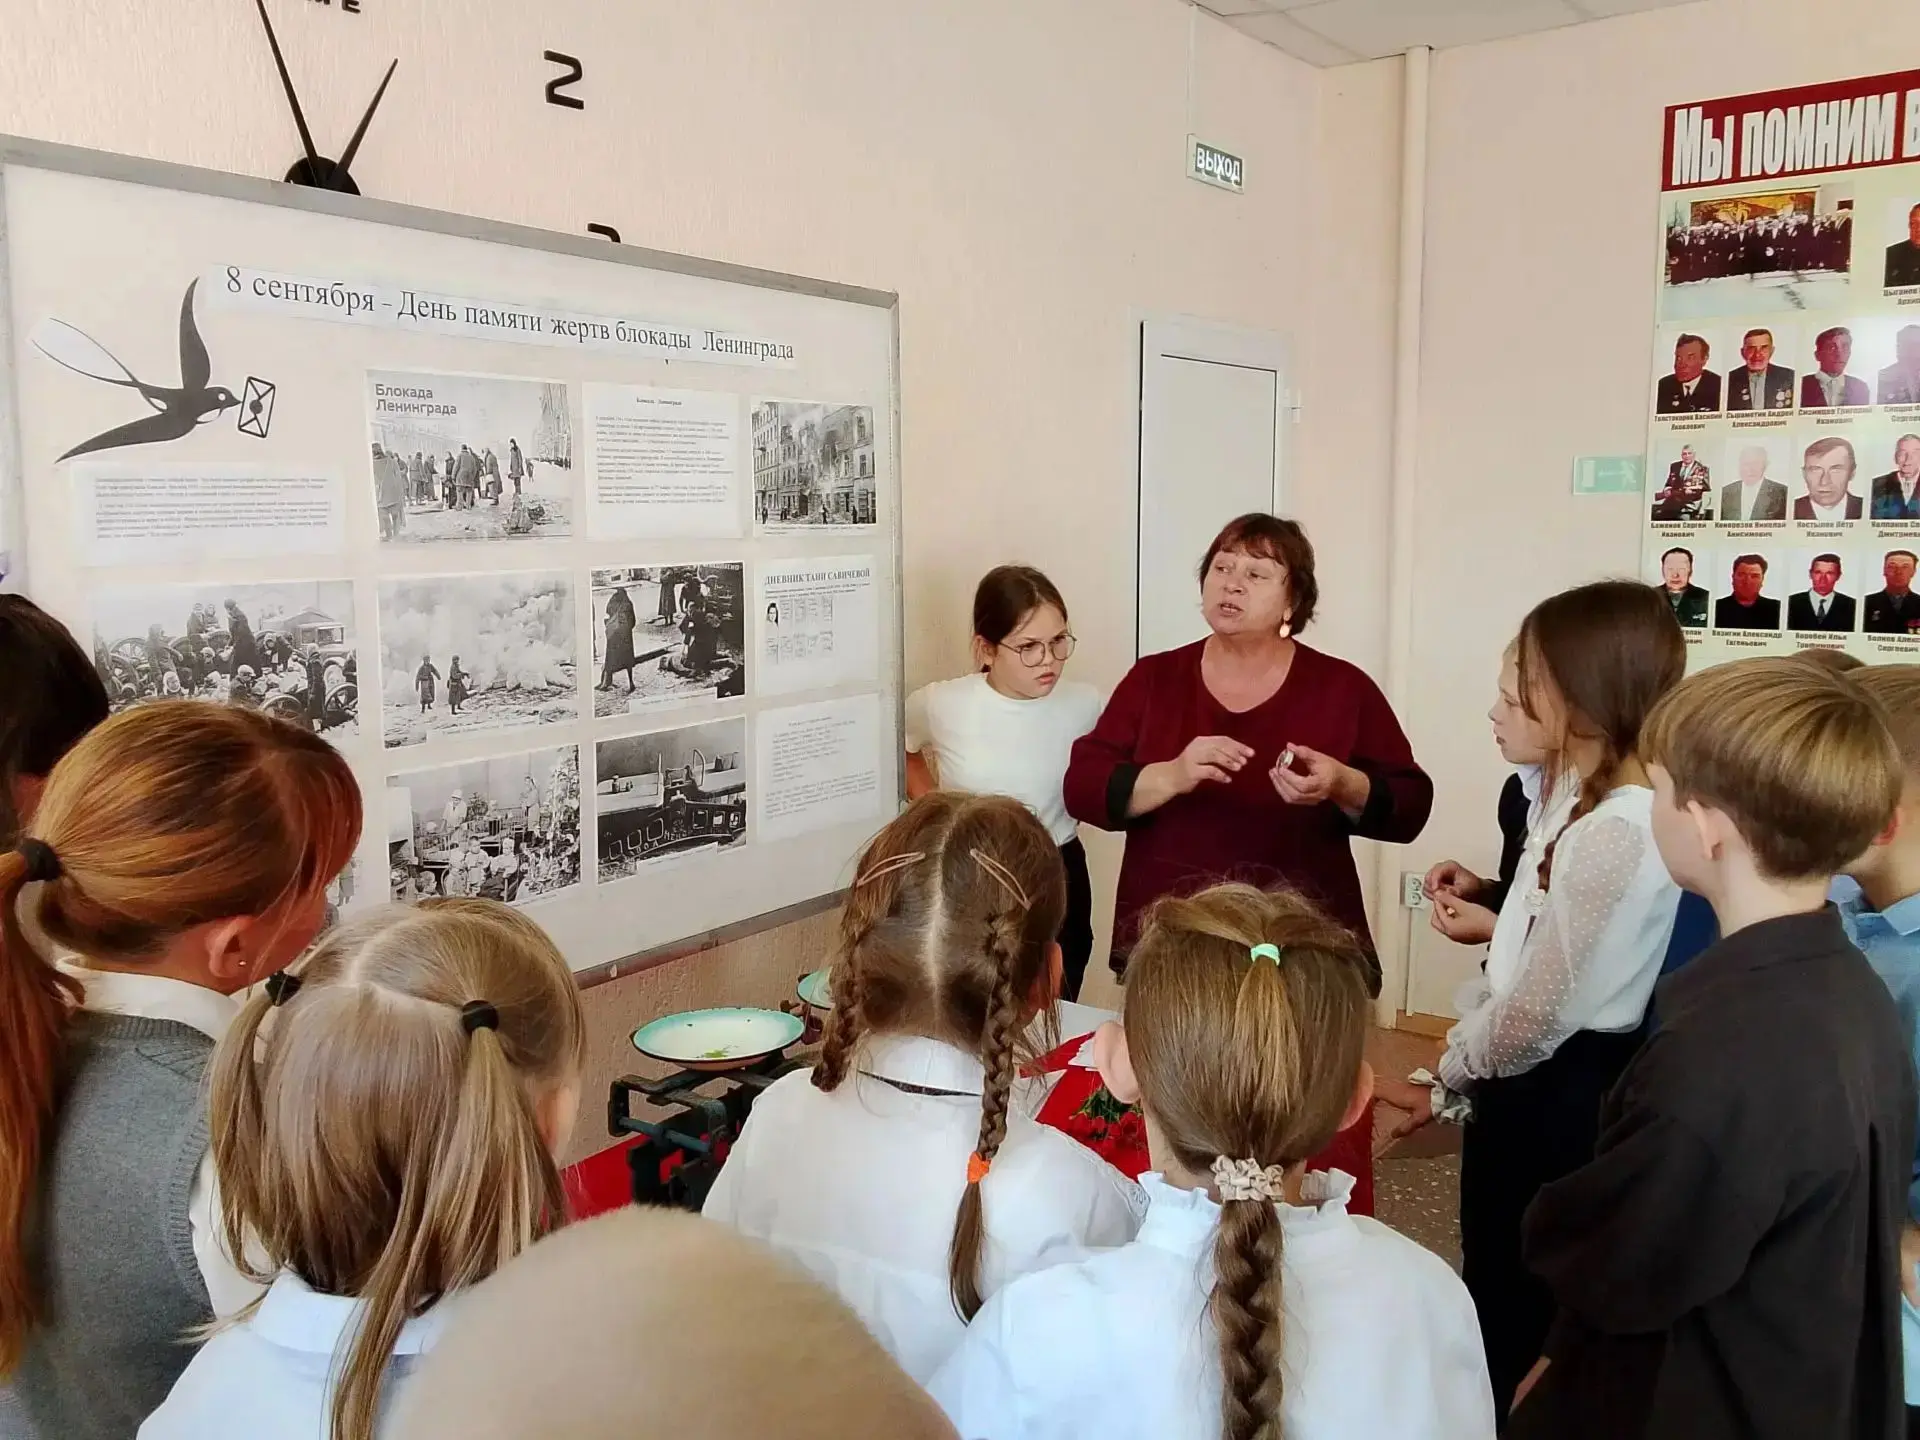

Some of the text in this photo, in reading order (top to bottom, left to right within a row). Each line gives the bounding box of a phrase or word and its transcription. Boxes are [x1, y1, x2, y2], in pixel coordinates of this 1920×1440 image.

[544, 49, 585, 110] 2
[1671, 106, 1735, 186] Мы
[1196, 147, 1241, 183] ВЫХОД
[226, 265, 242, 293] 8
[252, 276, 375, 316] сентября
[397, 290, 457, 322] День
[464, 305, 542, 332] памяти
[550, 317, 611, 343] жертв
[615, 321, 692, 350] блокады
[702, 330, 794, 361] Ленинграда
[375, 383, 434, 400] Блокада
[376, 399, 457, 416] Ленинграда
[764, 567, 871, 586] ДНЕВНИК ТАНИ САВИЧЕВОЙ
